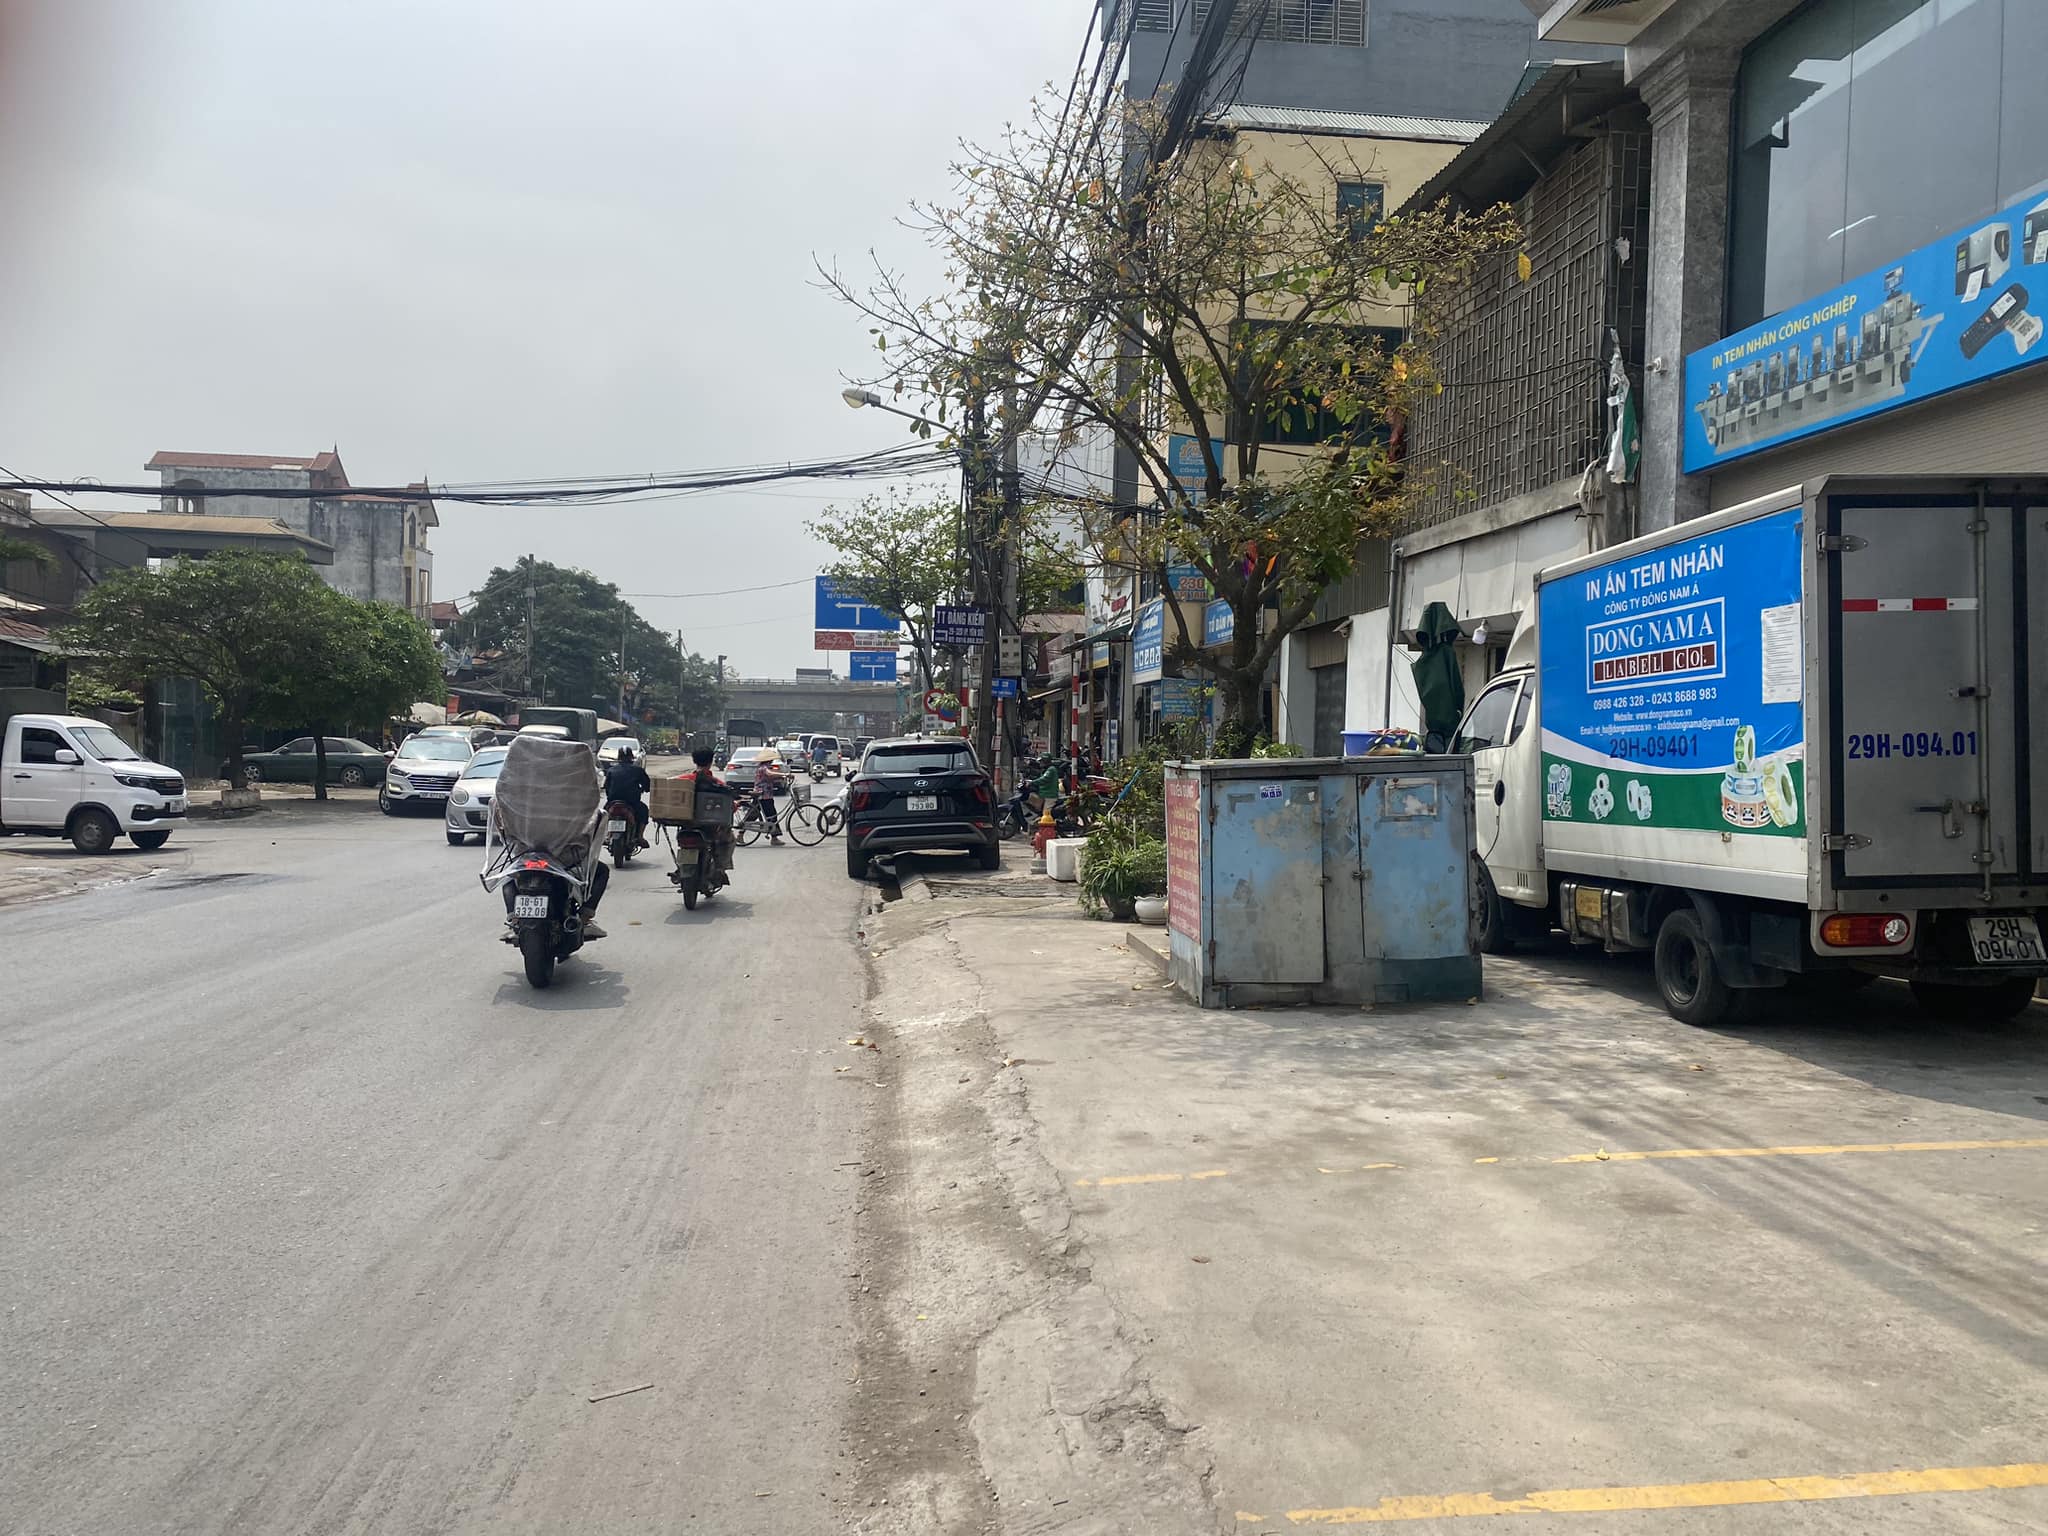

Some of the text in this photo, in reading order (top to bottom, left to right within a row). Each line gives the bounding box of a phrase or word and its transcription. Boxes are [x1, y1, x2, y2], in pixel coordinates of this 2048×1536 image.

[1712, 355, 1723, 370] IN
[1724, 344, 1745, 364] TEM
[1778, 316, 1810, 341] CÔNG
[1812, 294, 1857, 326] NGHIỆP
[1586, 578, 1600, 601] IN
[1630, 560, 1665, 589] TEM
[1671, 544, 1724, 580] NHÃN
[1604, 599, 1628, 615] CÔNG
[1629, 596, 1640, 610] TY
[1669, 585, 1690, 601] NAM
[936, 607, 985, 626] TT ĐĂNG KIỂM
[1593, 610, 1714, 655] DONG NAM A
[1606, 650, 1707, 679] LABEL CO.
[1593, 699, 1612, 710] 0988
[1613, 697, 1627, 709] 426
[1629, 695, 1644, 707] 328
[1652, 691, 1673, 705] 0243
[1674, 689, 1697, 703] 8688
[1699, 687, 1717, 700] 983
[1610, 734, 1698, 759] 29H-09401
[1848, 731, 1977, 759] 29H-094.01
[1985, 918, 2023, 938] 29H
